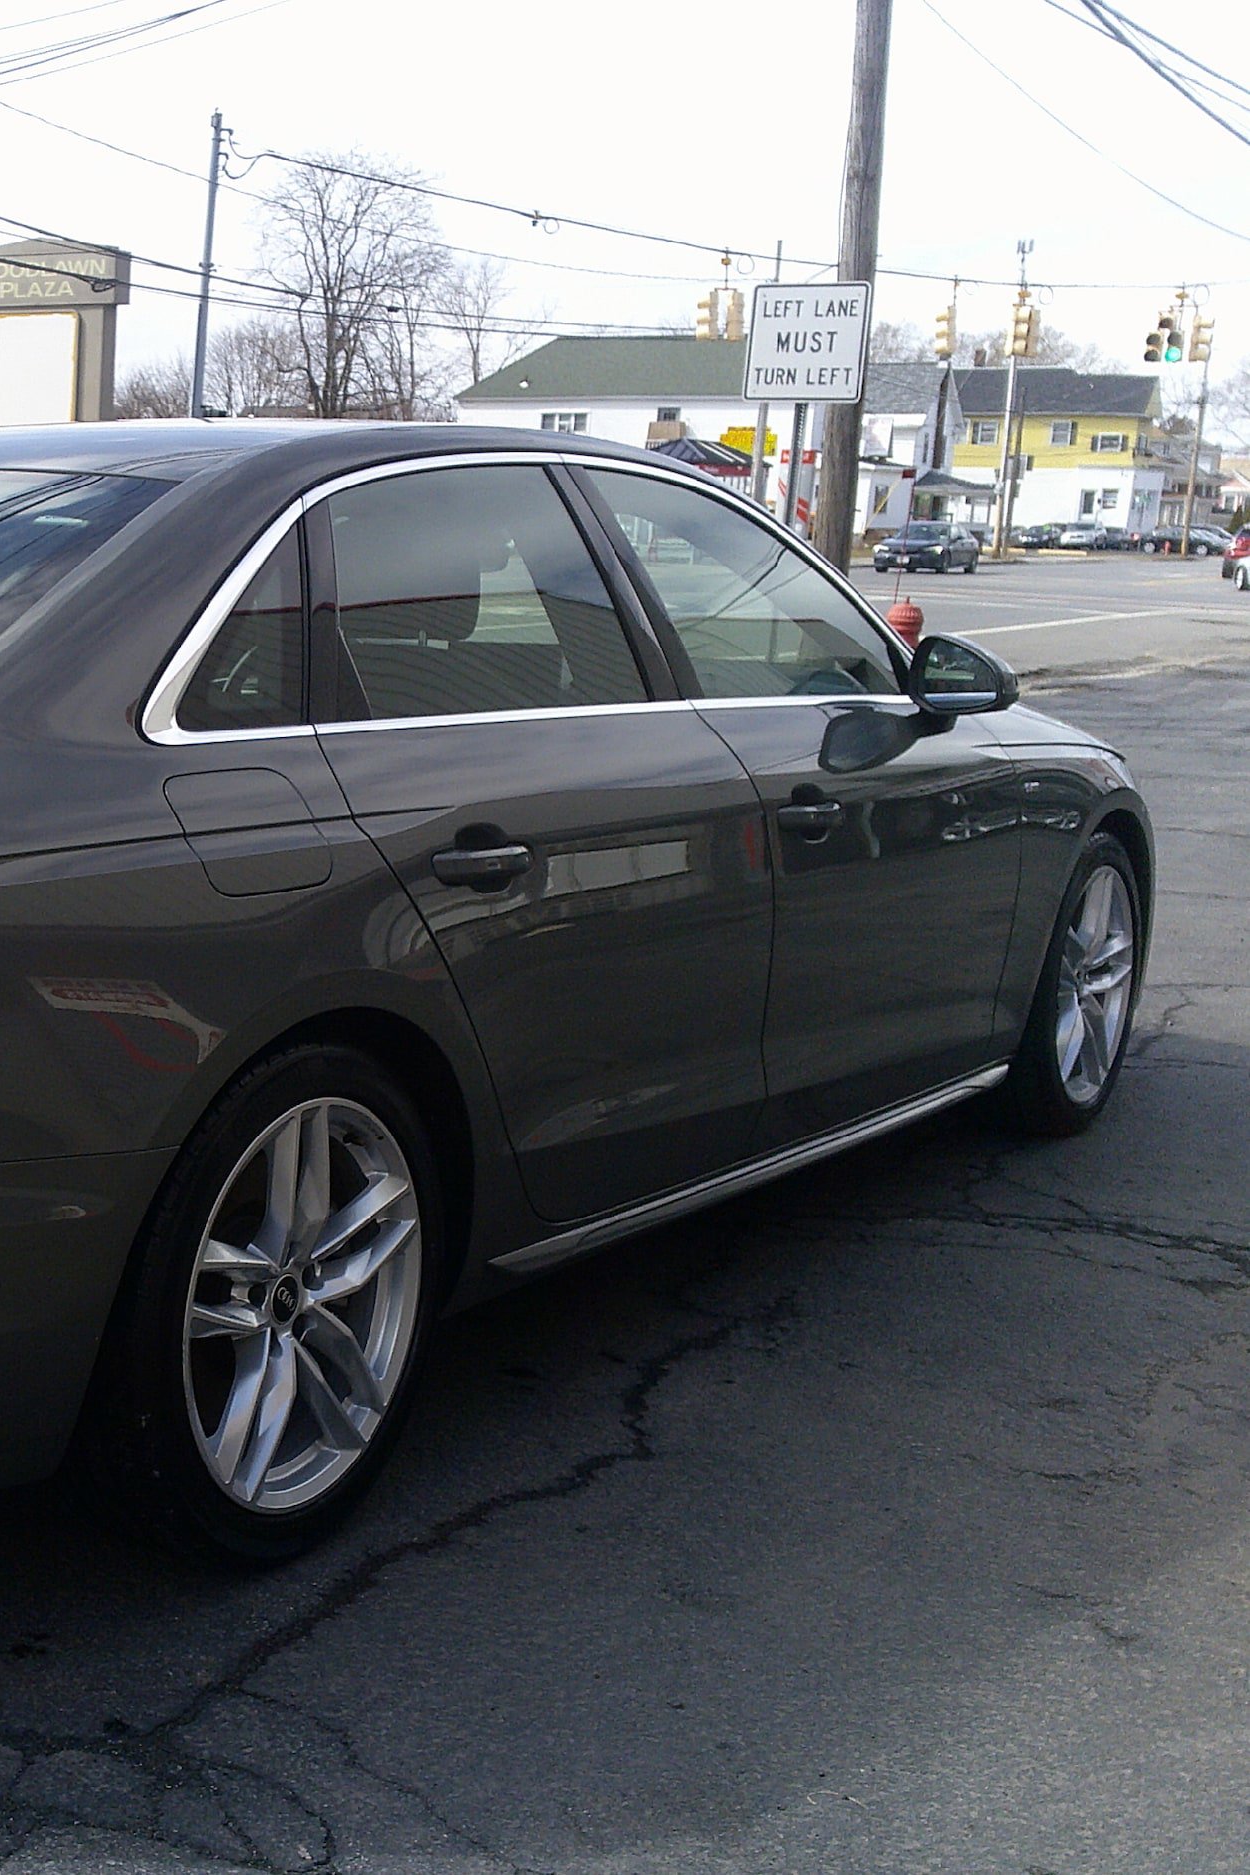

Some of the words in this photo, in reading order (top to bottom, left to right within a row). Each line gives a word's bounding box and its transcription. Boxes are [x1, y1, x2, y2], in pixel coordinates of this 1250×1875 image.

[0, 281, 74, 298] PLAZA
[763, 300, 804, 318] LEFT
[814, 299, 859, 317] LANE
[776, 331, 838, 353] MUST
[755, 367, 797, 385] TURN
[806, 367, 852, 385] LEFT
